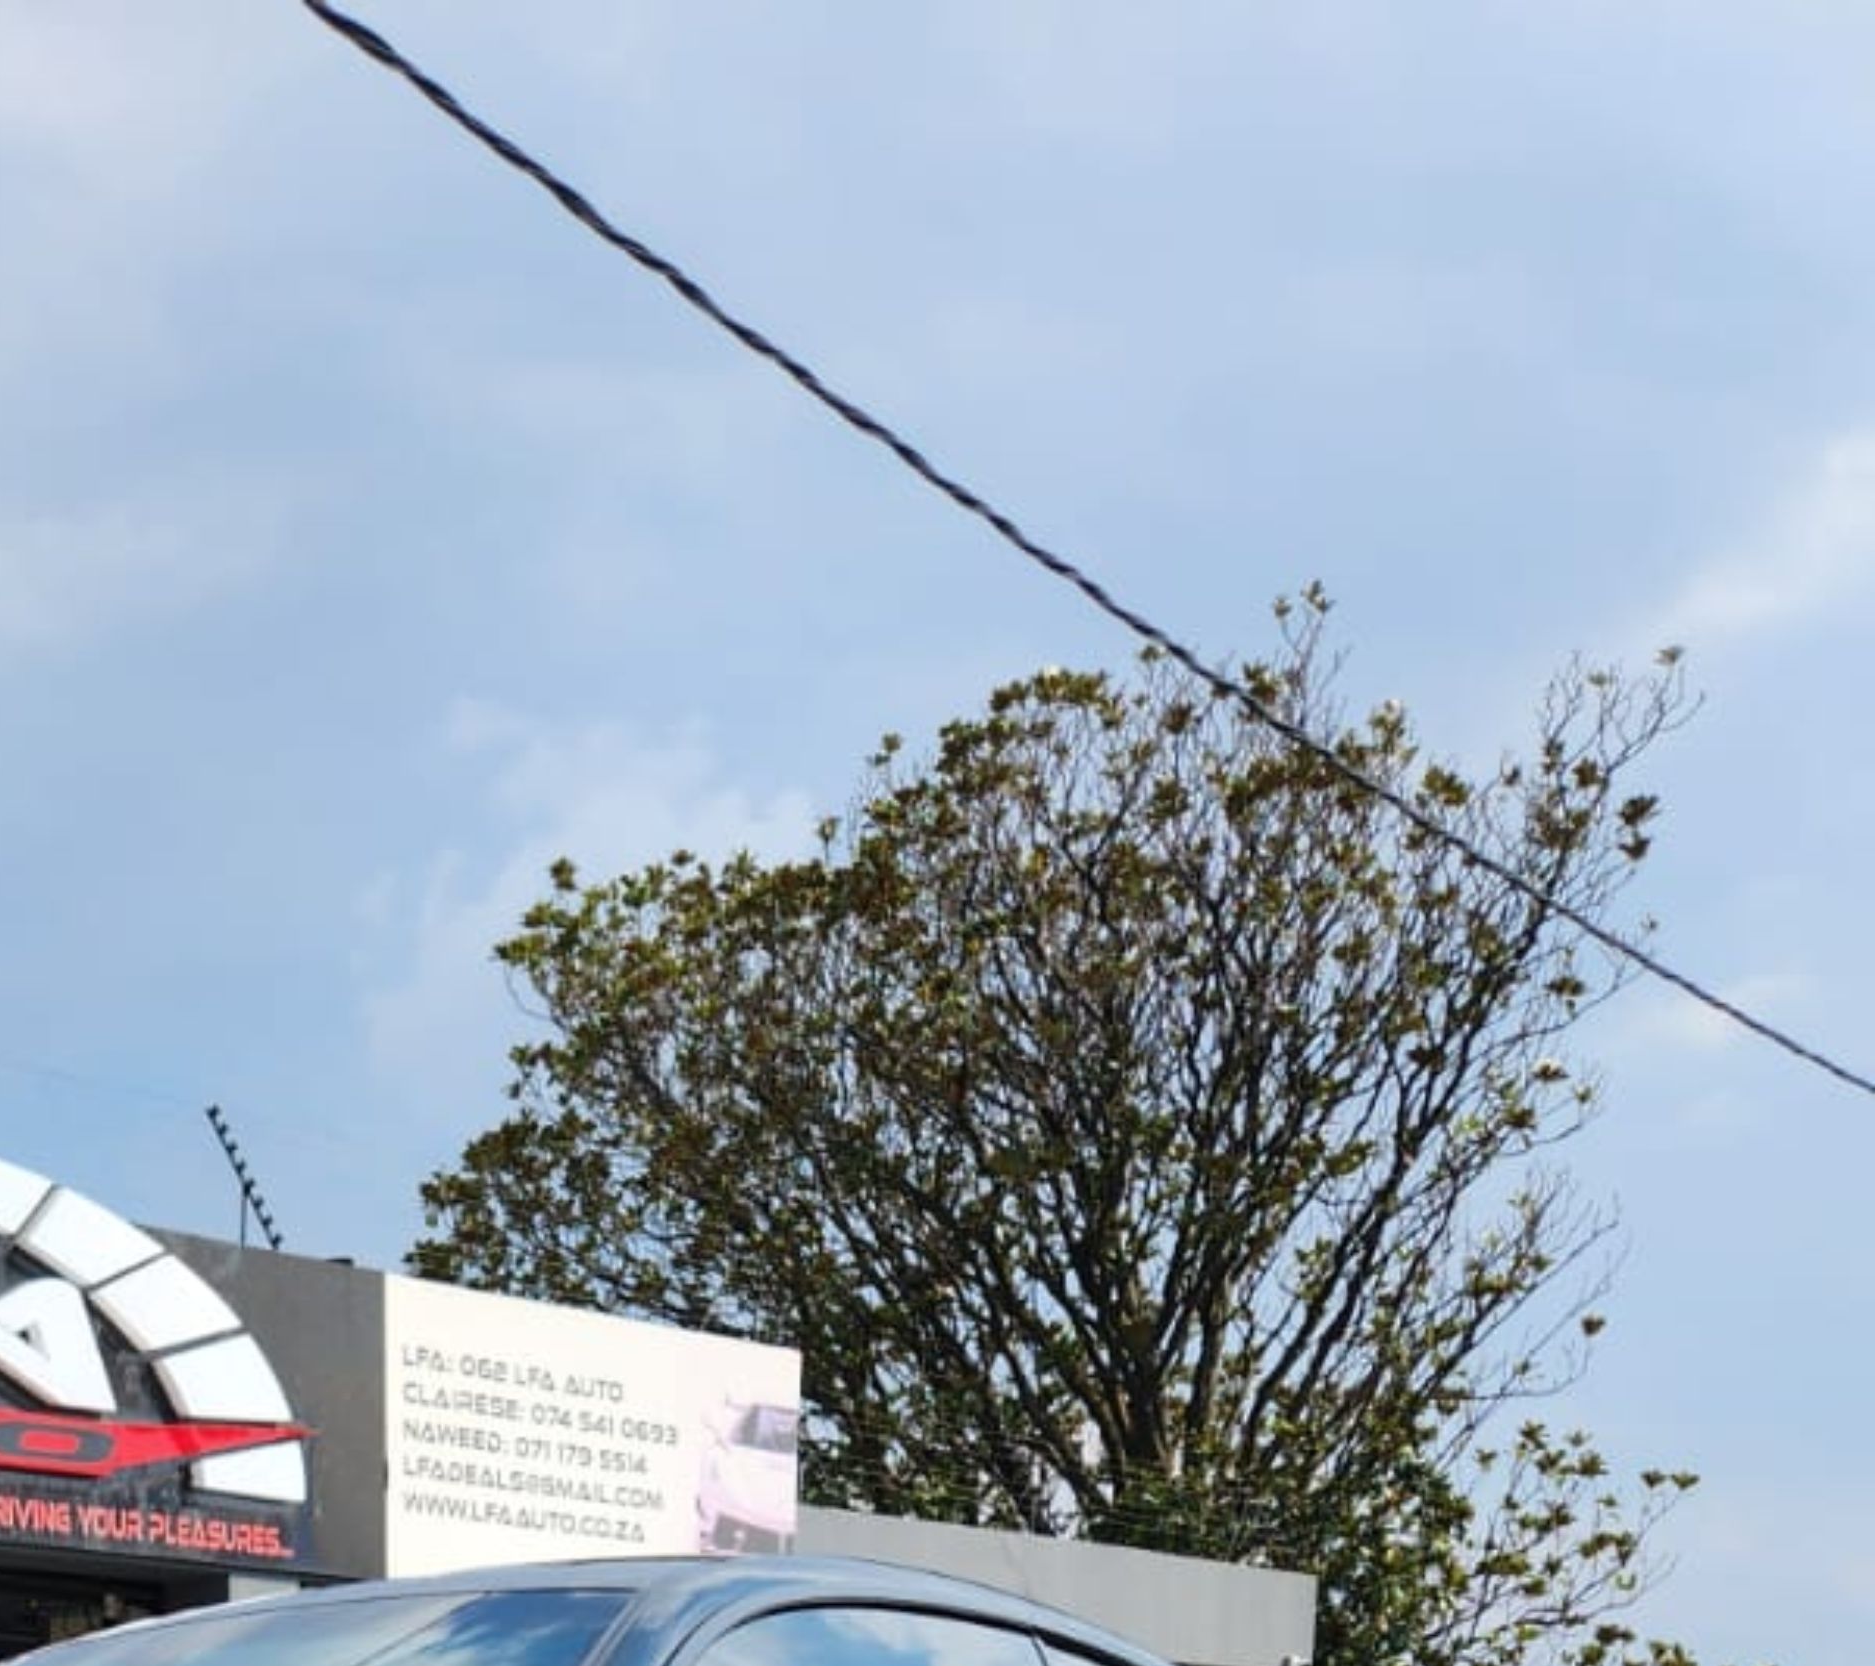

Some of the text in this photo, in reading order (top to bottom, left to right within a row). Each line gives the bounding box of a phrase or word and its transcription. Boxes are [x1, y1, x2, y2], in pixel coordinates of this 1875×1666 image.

[513, 1363, 554, 1391] LFA
[564, 1373, 624, 1403] AUTO
[531, 1402, 573, 1428] 074
[78, 1505, 144, 1543] YOUR
